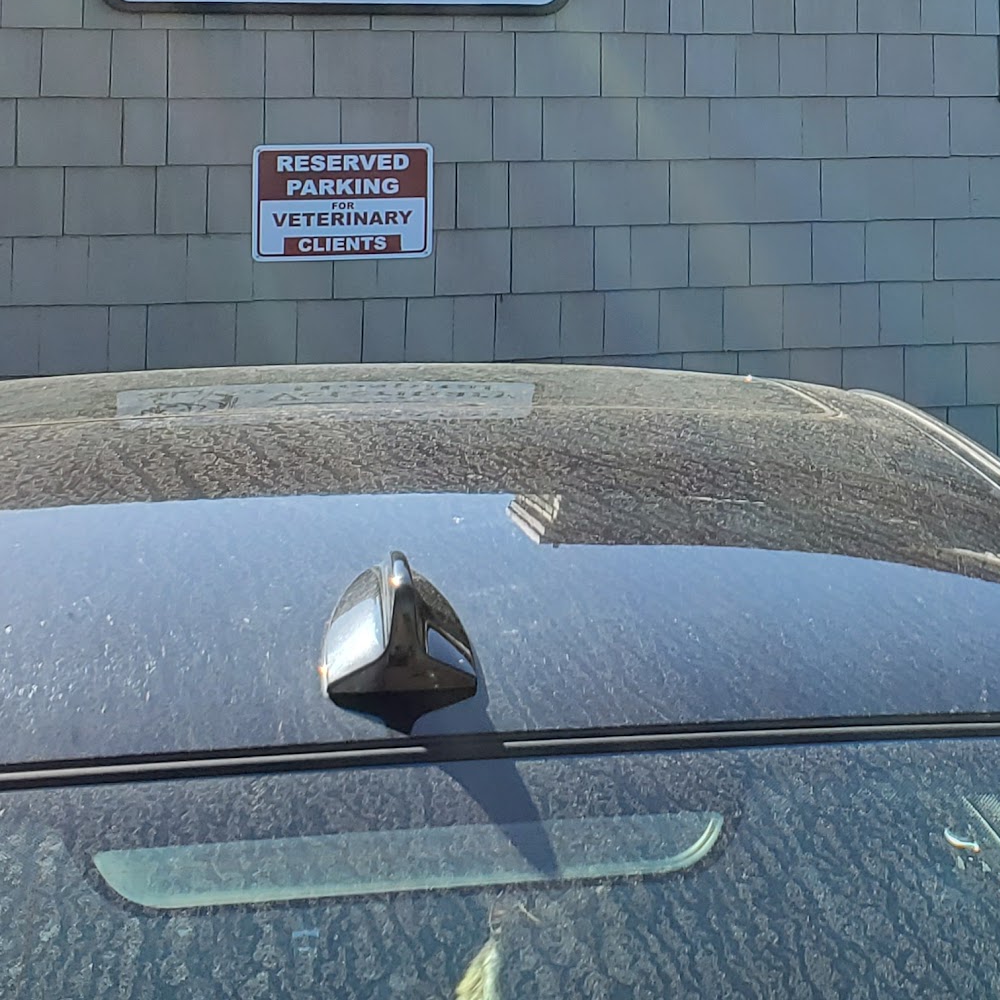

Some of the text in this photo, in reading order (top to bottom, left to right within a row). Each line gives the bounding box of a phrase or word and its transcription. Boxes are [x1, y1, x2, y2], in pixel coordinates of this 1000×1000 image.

[276, 153, 410, 173] RESERVED
[286, 177, 400, 196] PARKING
[331, 202, 355, 210] FOR
[272, 210, 413, 227] VETERINARY
[298, 236, 387, 252] CLIENTS
